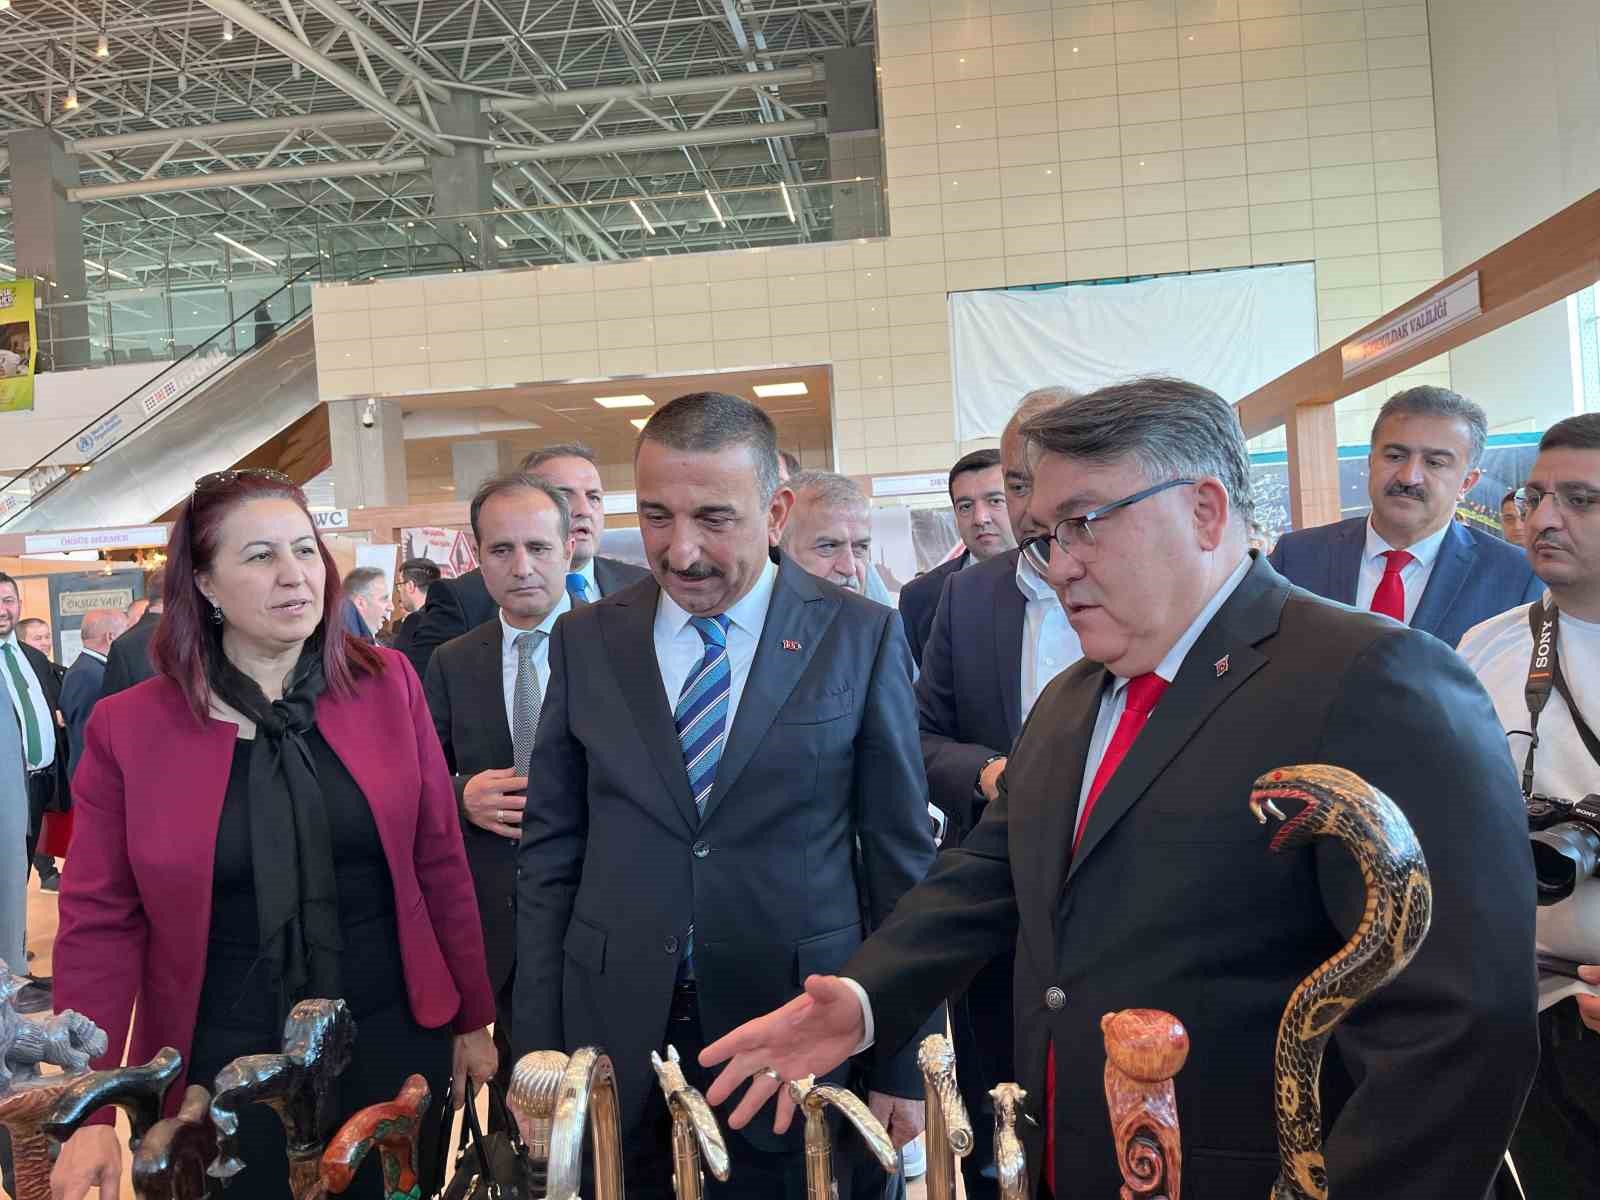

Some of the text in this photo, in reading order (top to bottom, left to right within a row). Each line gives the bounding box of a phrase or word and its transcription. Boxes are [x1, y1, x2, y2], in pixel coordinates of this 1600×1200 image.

[314, 511, 343, 526] WC
[1536, 621, 1552, 668] SONY
[1576, 808, 1598, 818] SONY
